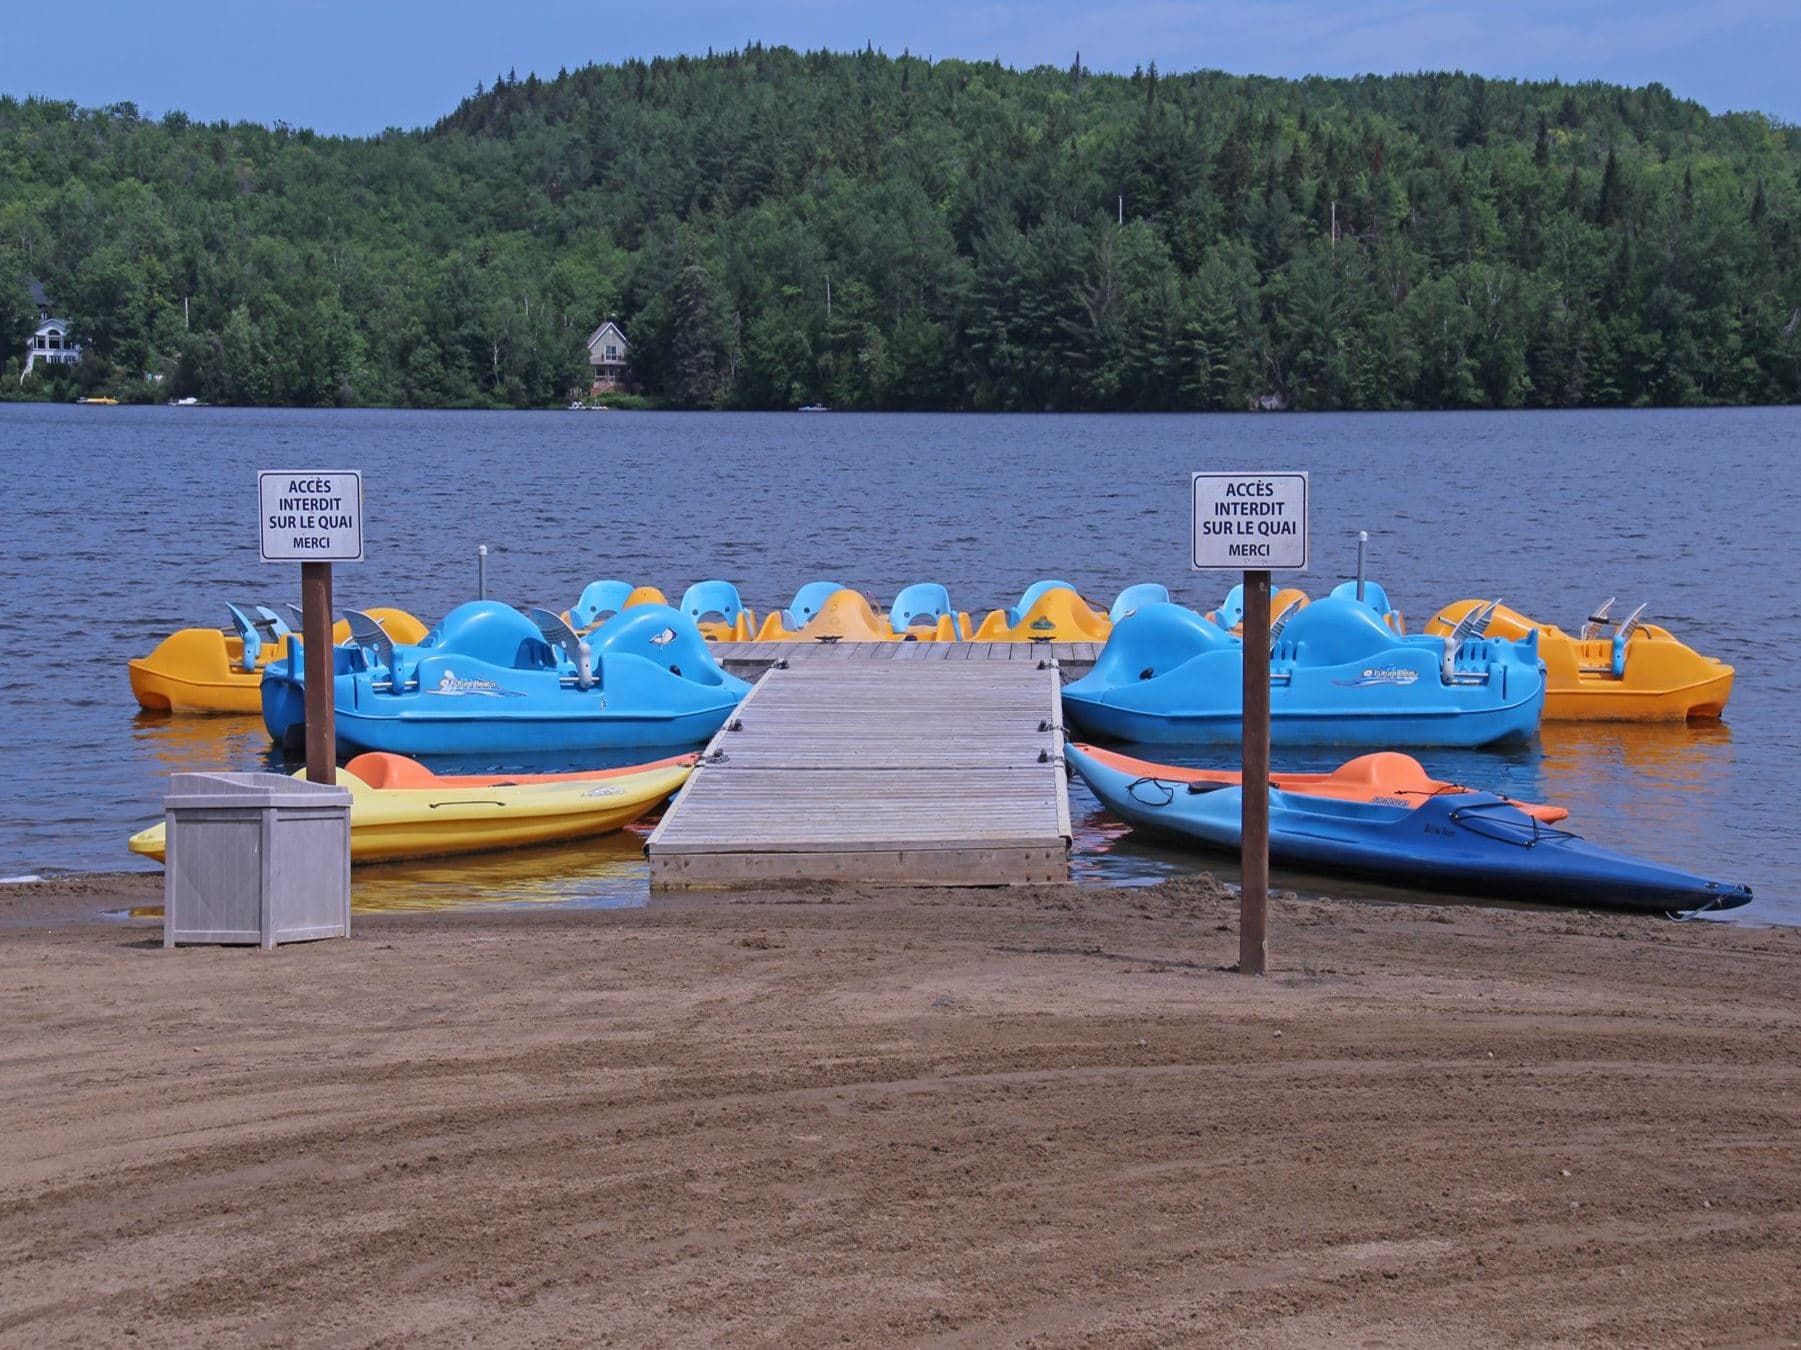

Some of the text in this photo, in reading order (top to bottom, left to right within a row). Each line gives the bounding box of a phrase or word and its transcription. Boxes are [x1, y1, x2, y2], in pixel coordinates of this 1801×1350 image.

[289, 477, 331, 493] ACCÈS
[1226, 480, 1274, 497] ACCÈS
[279, 498, 342, 511] INTERDIT
[1215, 502, 1285, 516] INTERDIT
[269, 515, 352, 530] SUR LE QUAI
[1203, 521, 1296, 537] SUR LE QUAI
[293, 537, 330, 549] MERCI
[1229, 544, 1270, 556] MERCI
